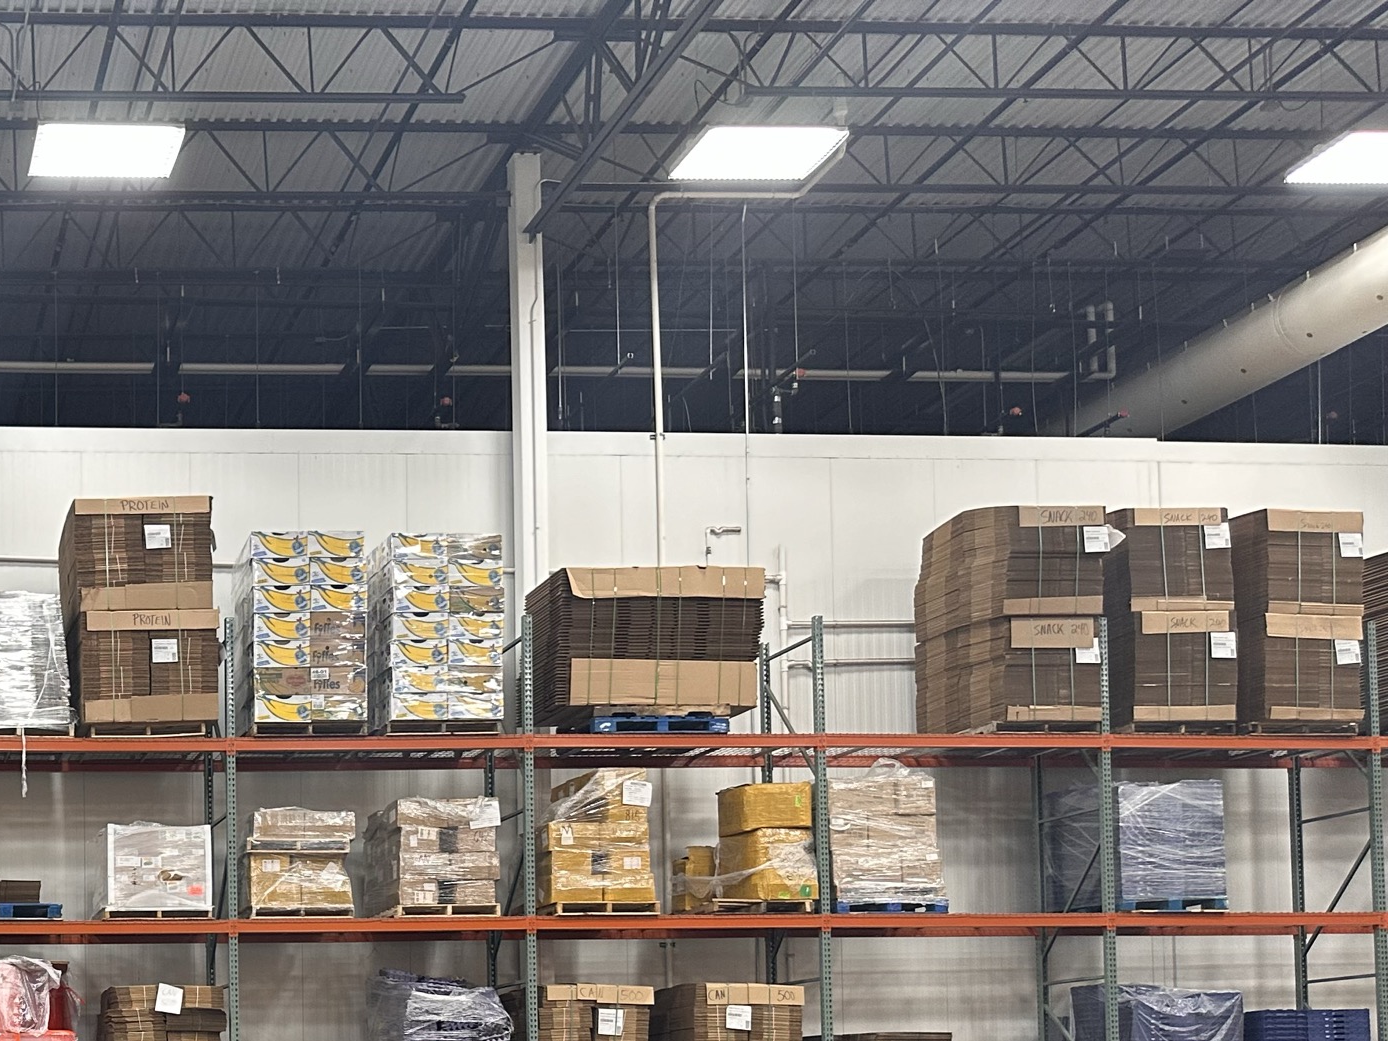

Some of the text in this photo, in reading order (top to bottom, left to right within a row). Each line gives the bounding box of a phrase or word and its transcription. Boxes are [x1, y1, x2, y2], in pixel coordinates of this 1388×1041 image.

[120, 499, 169, 511] PROTEIN
[1040, 509, 1098, 524] SNACK 240
[1163, 512, 1193, 523] SNACK
[132, 612, 172, 626] PROTEIN
[1170, 616, 1198, 629] SNACK
[1033, 624, 1065, 636] SNACK
[580, 986, 644, 1000] CAN 500
[708, 989, 795, 1001] CAN 500
